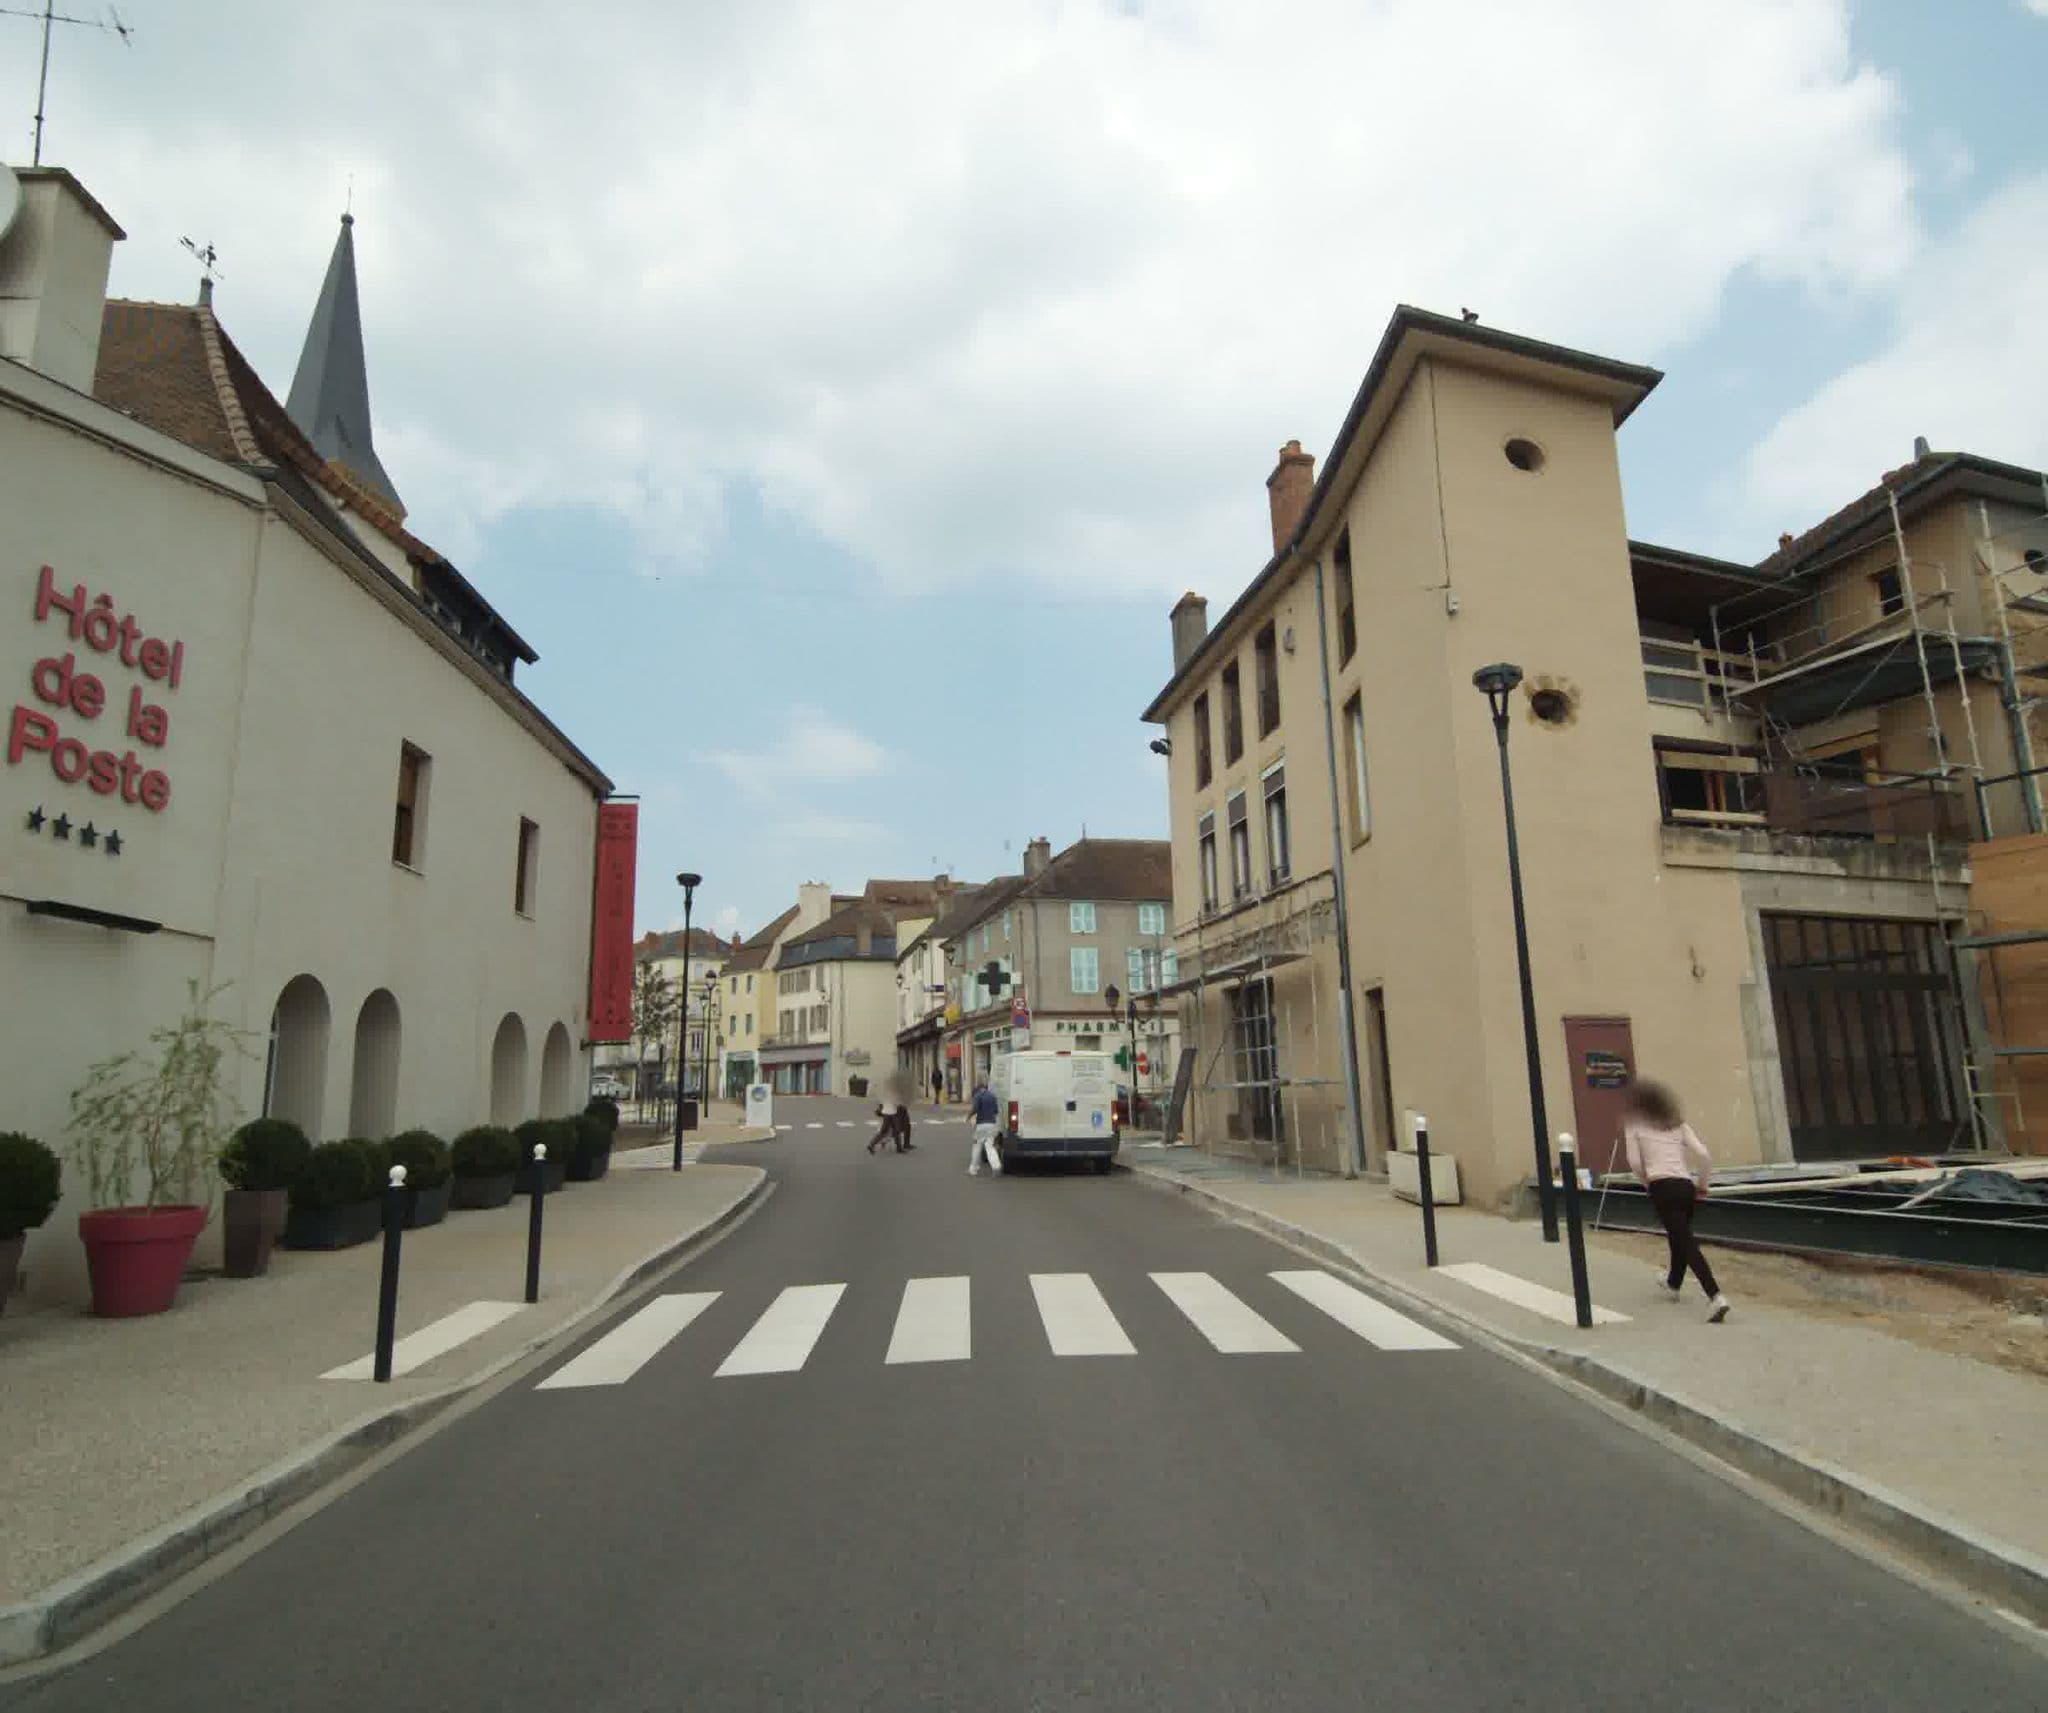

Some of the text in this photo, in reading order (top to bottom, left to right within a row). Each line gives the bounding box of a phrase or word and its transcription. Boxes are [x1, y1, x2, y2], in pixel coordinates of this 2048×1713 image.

[35, 565, 184, 690] Hôtel
[32, 651, 168, 747] de la
[8, 702, 171, 813] Poste
